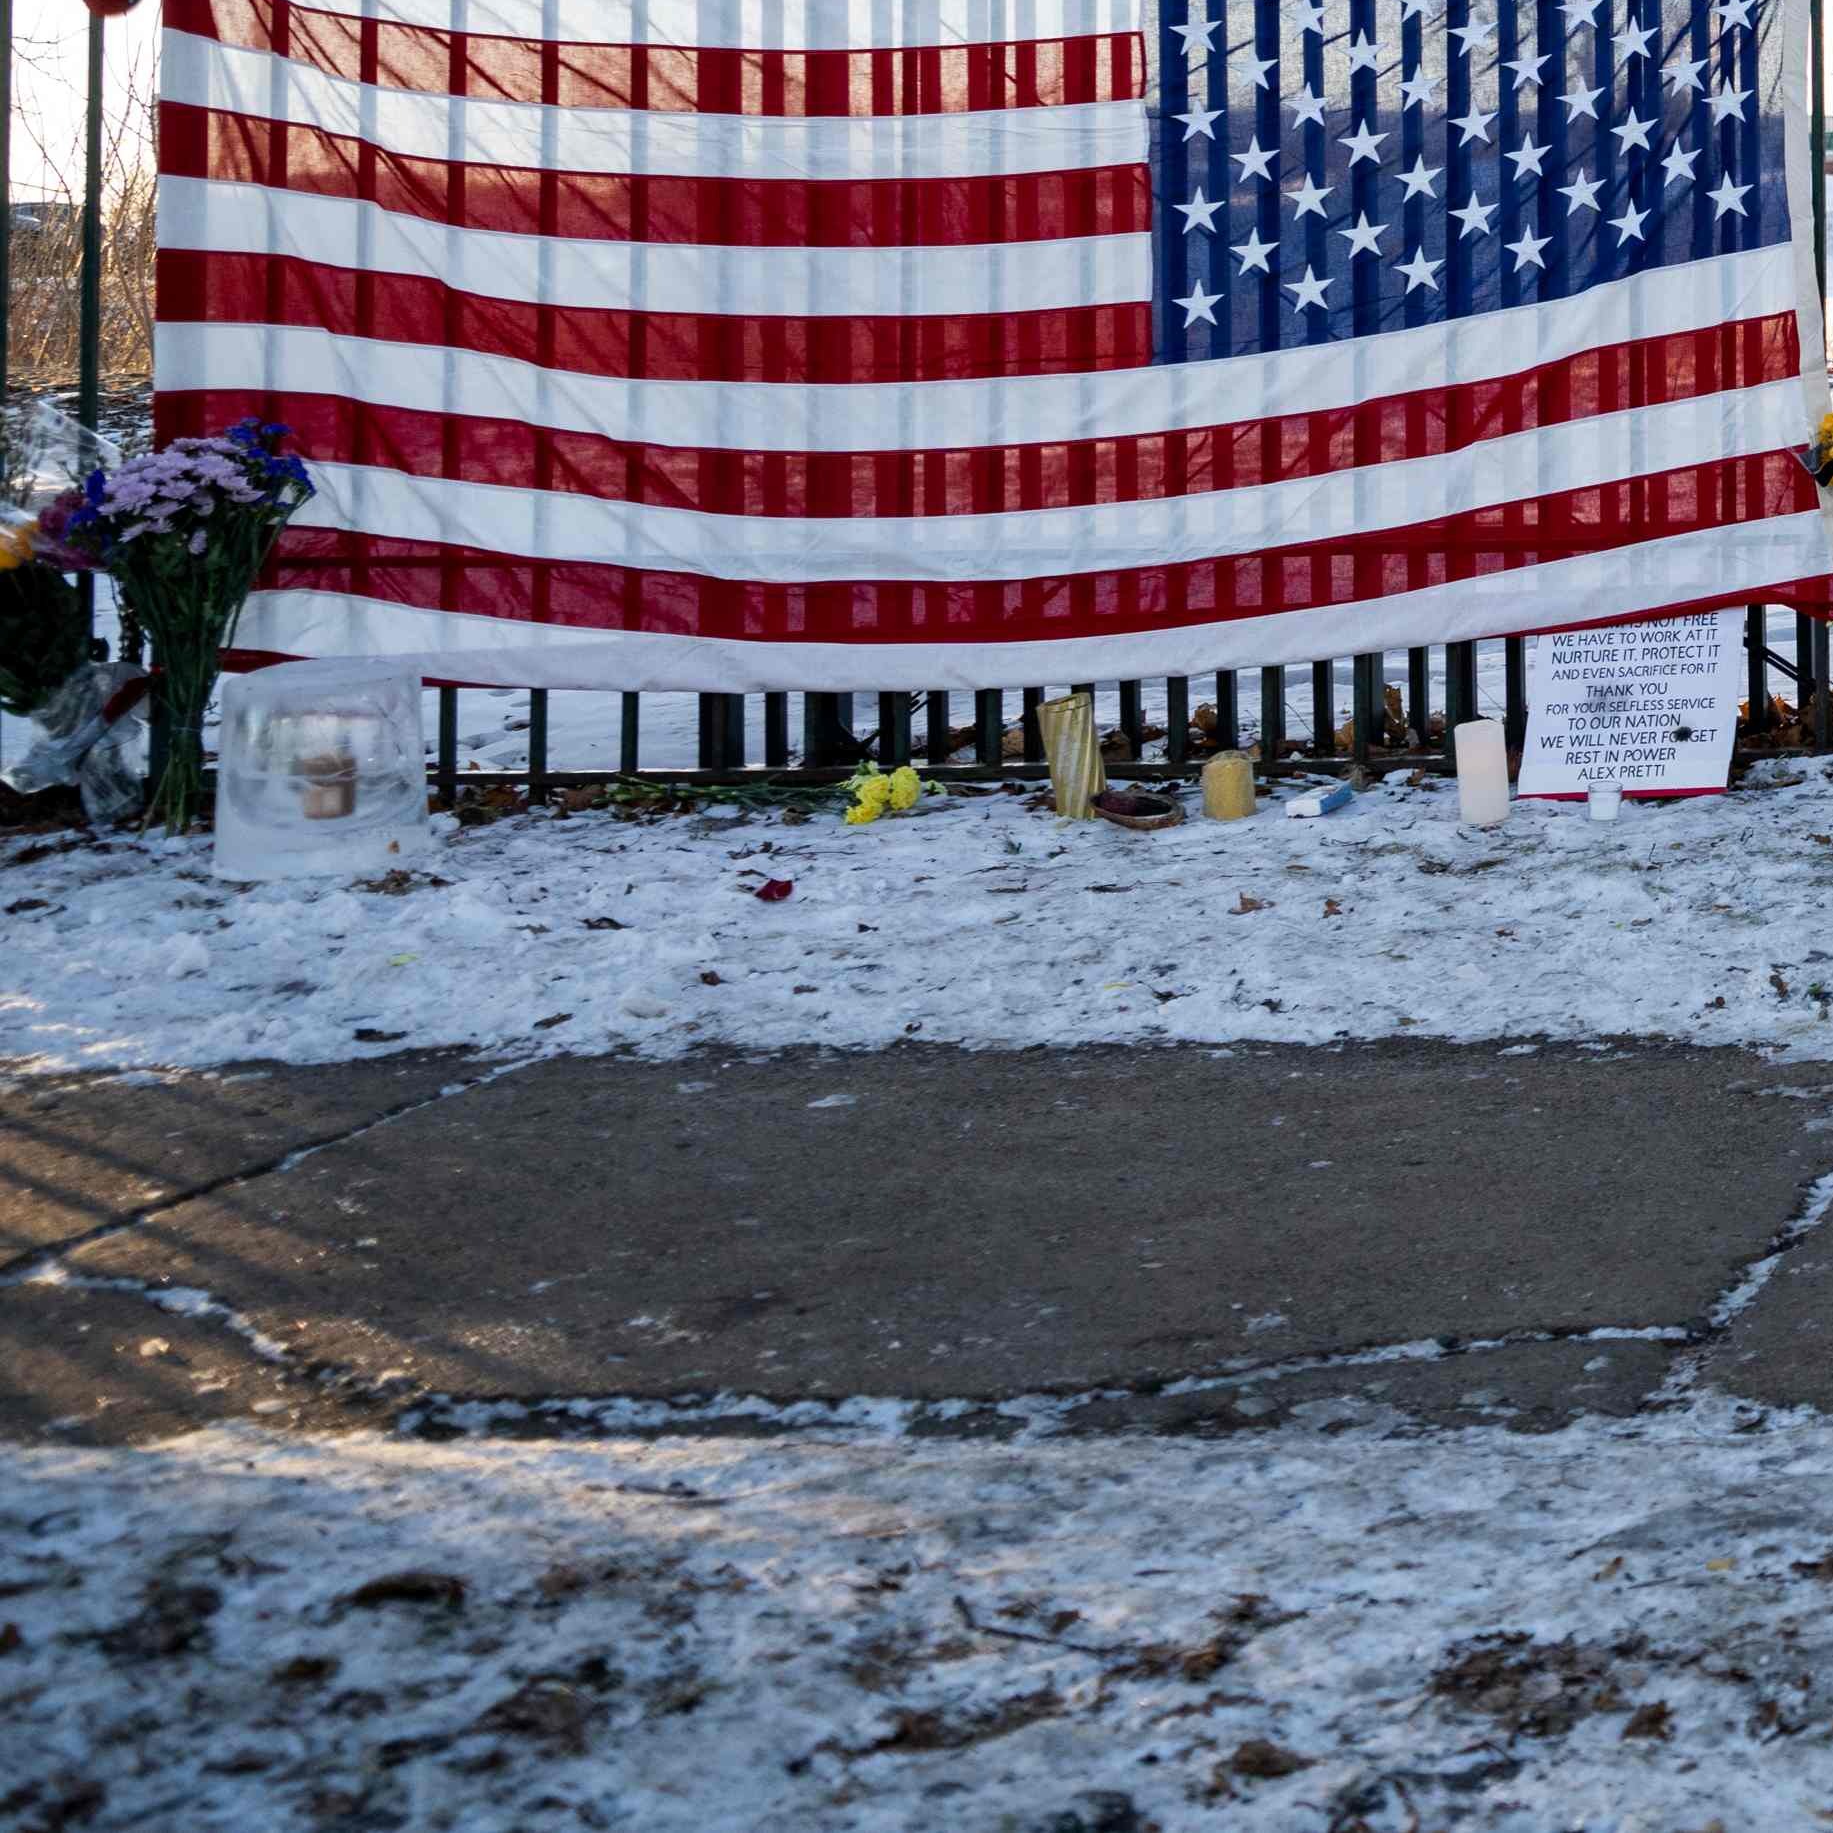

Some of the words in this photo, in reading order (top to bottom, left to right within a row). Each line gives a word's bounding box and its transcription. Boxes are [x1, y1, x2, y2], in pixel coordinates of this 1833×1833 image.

[1683, 612, 1720, 627] FREE
[1552, 634, 1575, 647] WE
[1577, 632, 1615, 646] HAVE
[1620, 631, 1637, 644] TO
[1641, 630, 1682, 643] WORK
[1685, 629, 1703, 642] AT
[1705, 628, 1719, 641] IT
[1551, 648, 1620, 665] NURTURE
[1642, 645, 1705, 660] PROTECT
[1708, 644, 1721, 658] IT
[1551, 668, 1580, 681] AND
[1582, 666, 1615, 679] EVEN
[1618, 664, 1678, 678] SACRIFICE
[1680, 663, 1704, 675] FOR
[1706, 662, 1719, 674] IT
[1586, 684, 1634, 698] THANK
[1639, 682, 1668, 695] YOU
[1546, 704, 1569, 716] FOR
[1573, 701, 1606, 715] YOUR
[1609, 699, 1665, 713] SELFLESS
[1667, 697, 1716, 710] SERVICE
[1568, 717, 1586, 731] TO
[1589, 716, 1622, 730] OUR
[1624, 714, 1681, 728] NATION
[1540, 735, 1564, 749] WE
[1569, 733, 1605, 748] WILL
[1608, 732, 1657, 745] NEVER
[1661, 729, 1718, 743] FOGET
[1565, 750, 1603, 765] REST
[1604, 749, 1620, 763] IN
[1623, 747, 1677, 762] POWER
[1576, 767, 1616, 781] ALEX
[1619, 764, 1666, 778] PRETTI
